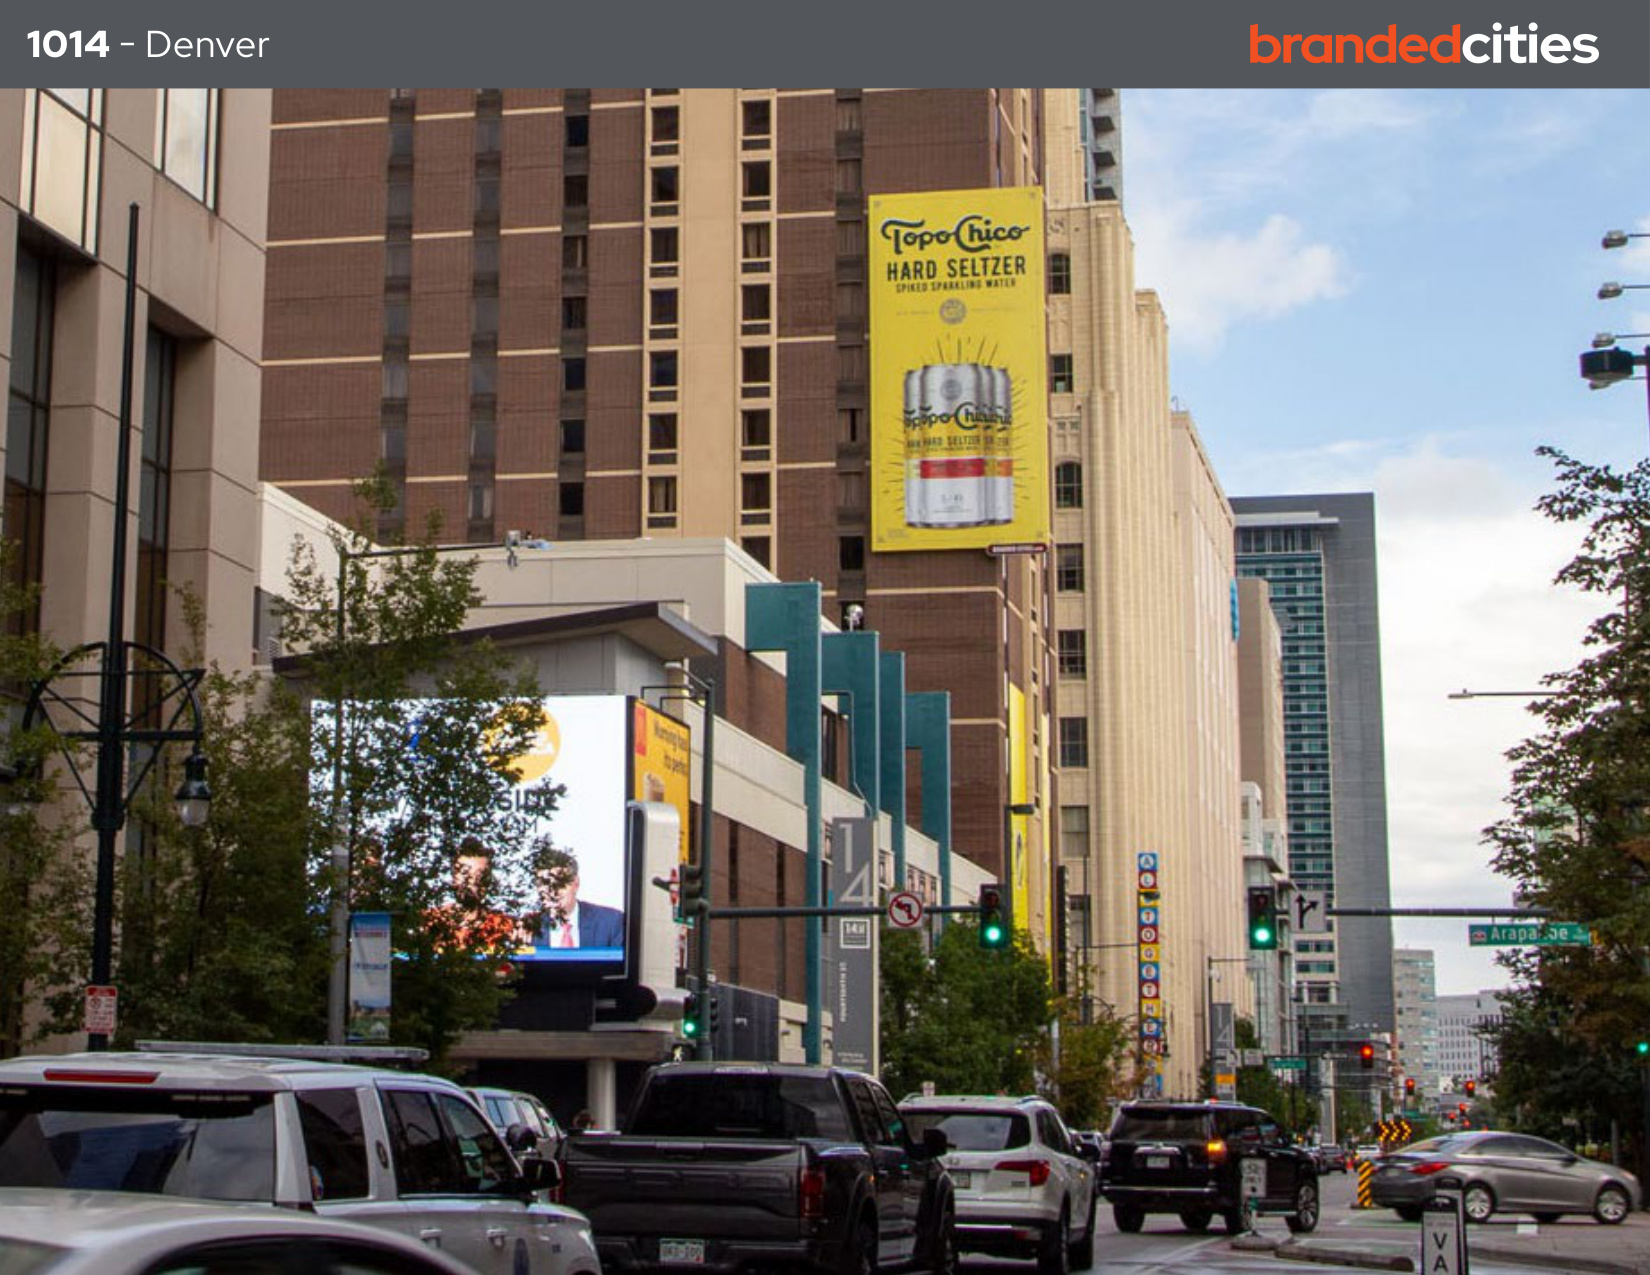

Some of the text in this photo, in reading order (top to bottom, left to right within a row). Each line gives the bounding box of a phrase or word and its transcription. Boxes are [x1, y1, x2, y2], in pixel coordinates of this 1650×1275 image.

[881, 214, 1030, 255] Topo Chico
[887, 255, 1026, 282] HARD SELTZER
[986, 277, 1016, 288] WATER
[840, 823, 875, 908] 14
